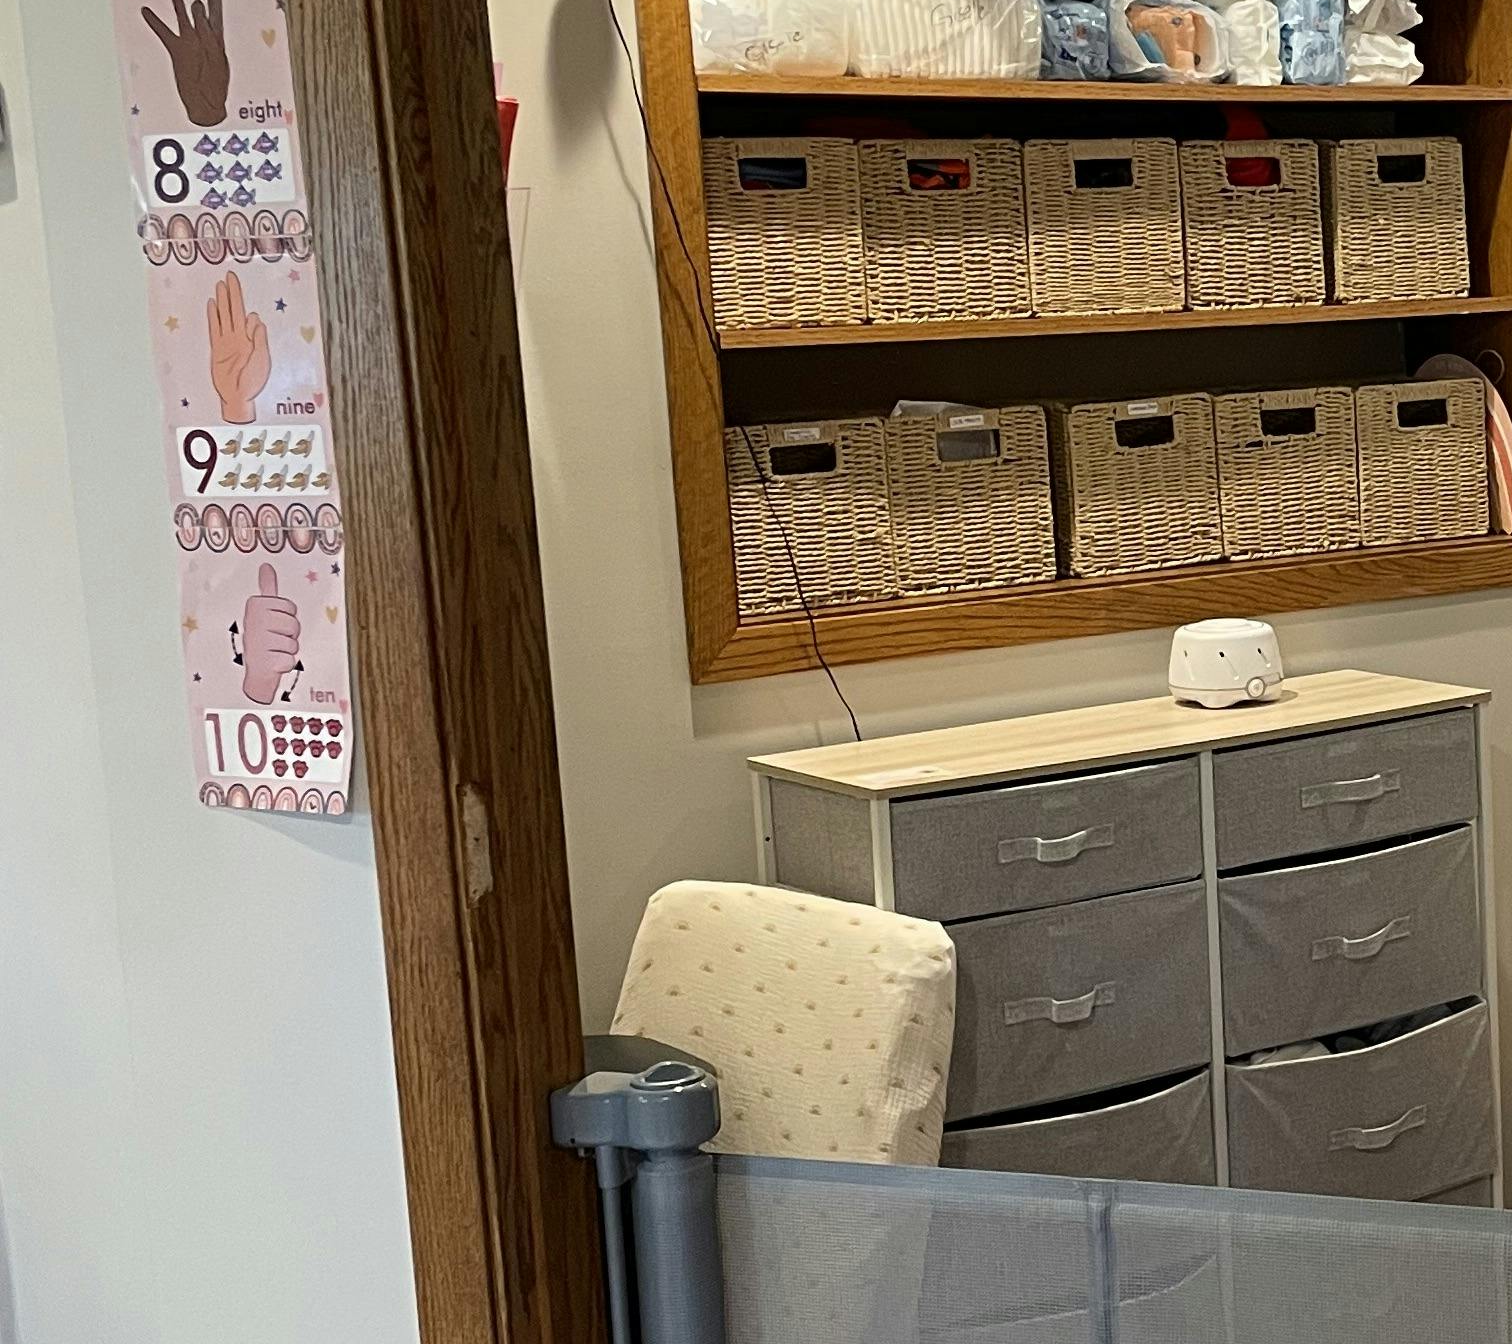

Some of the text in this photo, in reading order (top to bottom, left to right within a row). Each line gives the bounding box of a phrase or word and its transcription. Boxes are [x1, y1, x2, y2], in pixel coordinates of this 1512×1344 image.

[239, 99, 283, 123] eight
[152, 138, 190, 204] 8
[276, 397, 316, 415] nine
[183, 429, 218, 494] 9
[309, 687, 336, 703] ten
[206, 712, 268, 775] 10
